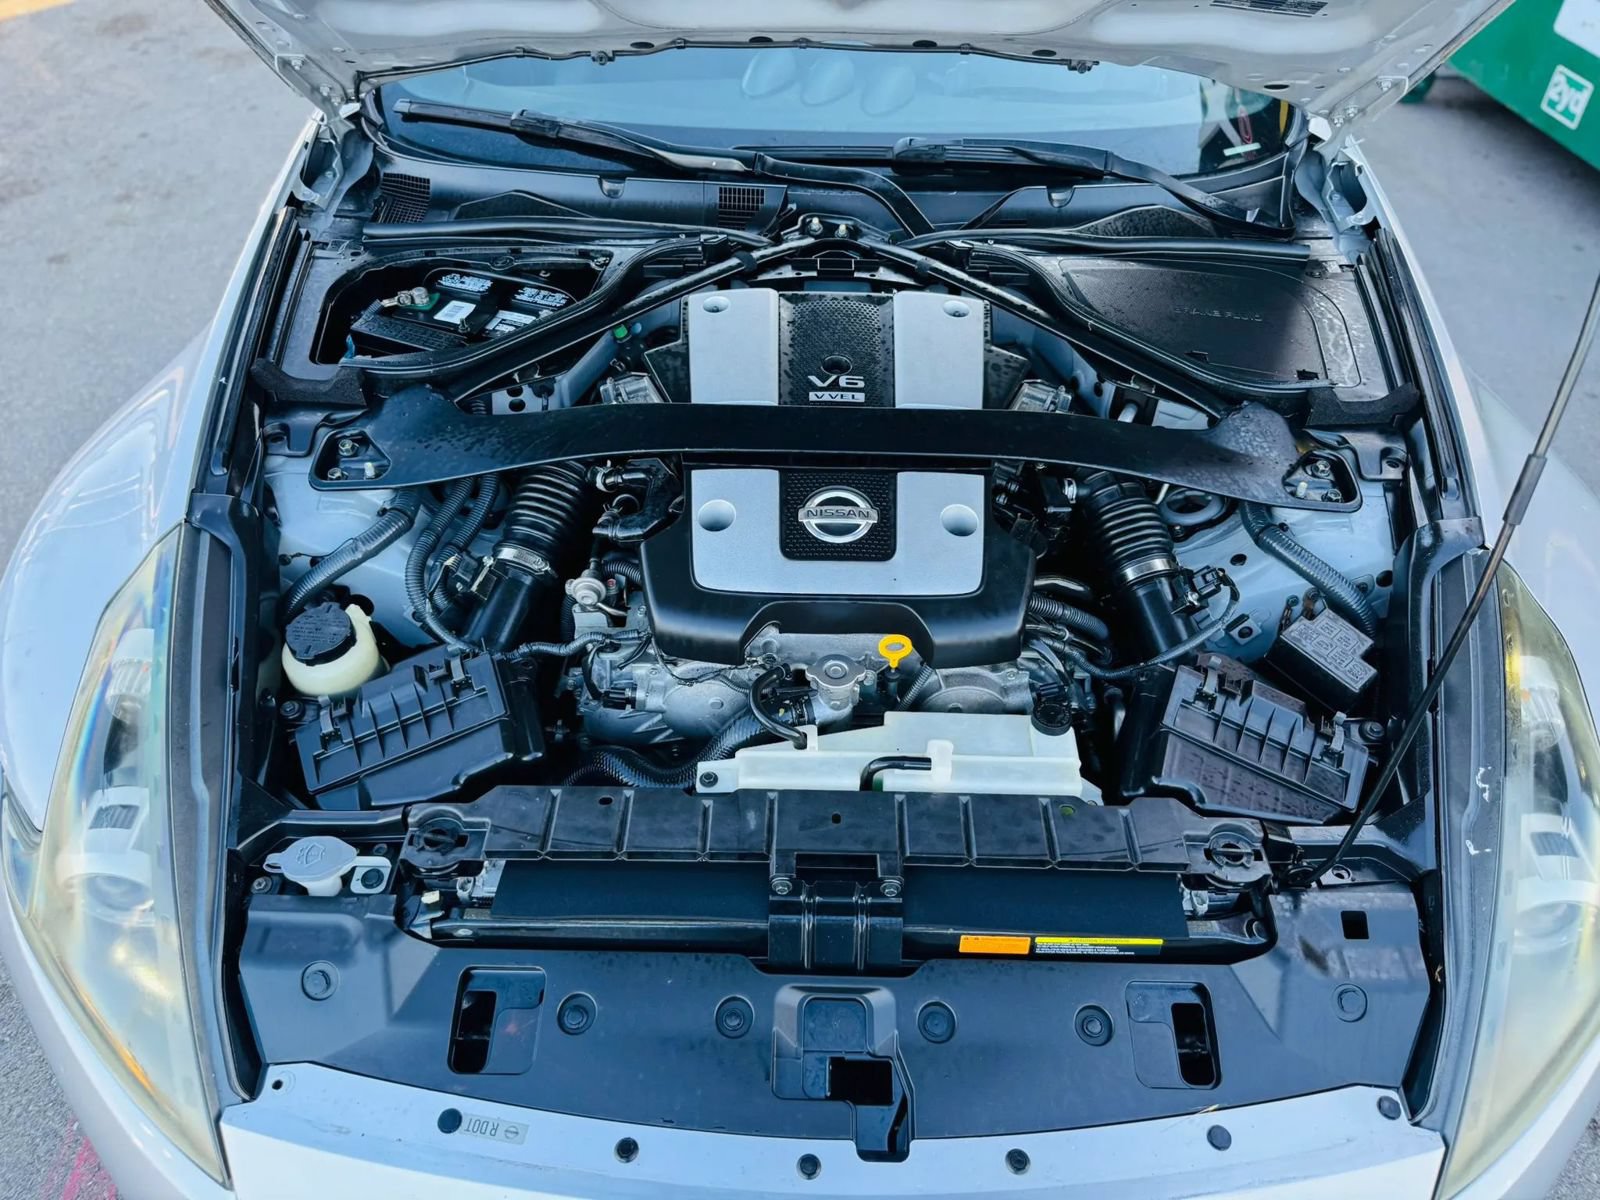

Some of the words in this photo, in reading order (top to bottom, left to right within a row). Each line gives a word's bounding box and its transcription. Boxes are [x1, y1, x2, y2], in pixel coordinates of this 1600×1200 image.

[1548, 72, 1589, 117] 2yd
[807, 375, 865, 388] V6
[806, 508, 870, 519] NISSAN
[489, 1122, 500, 1137] R
